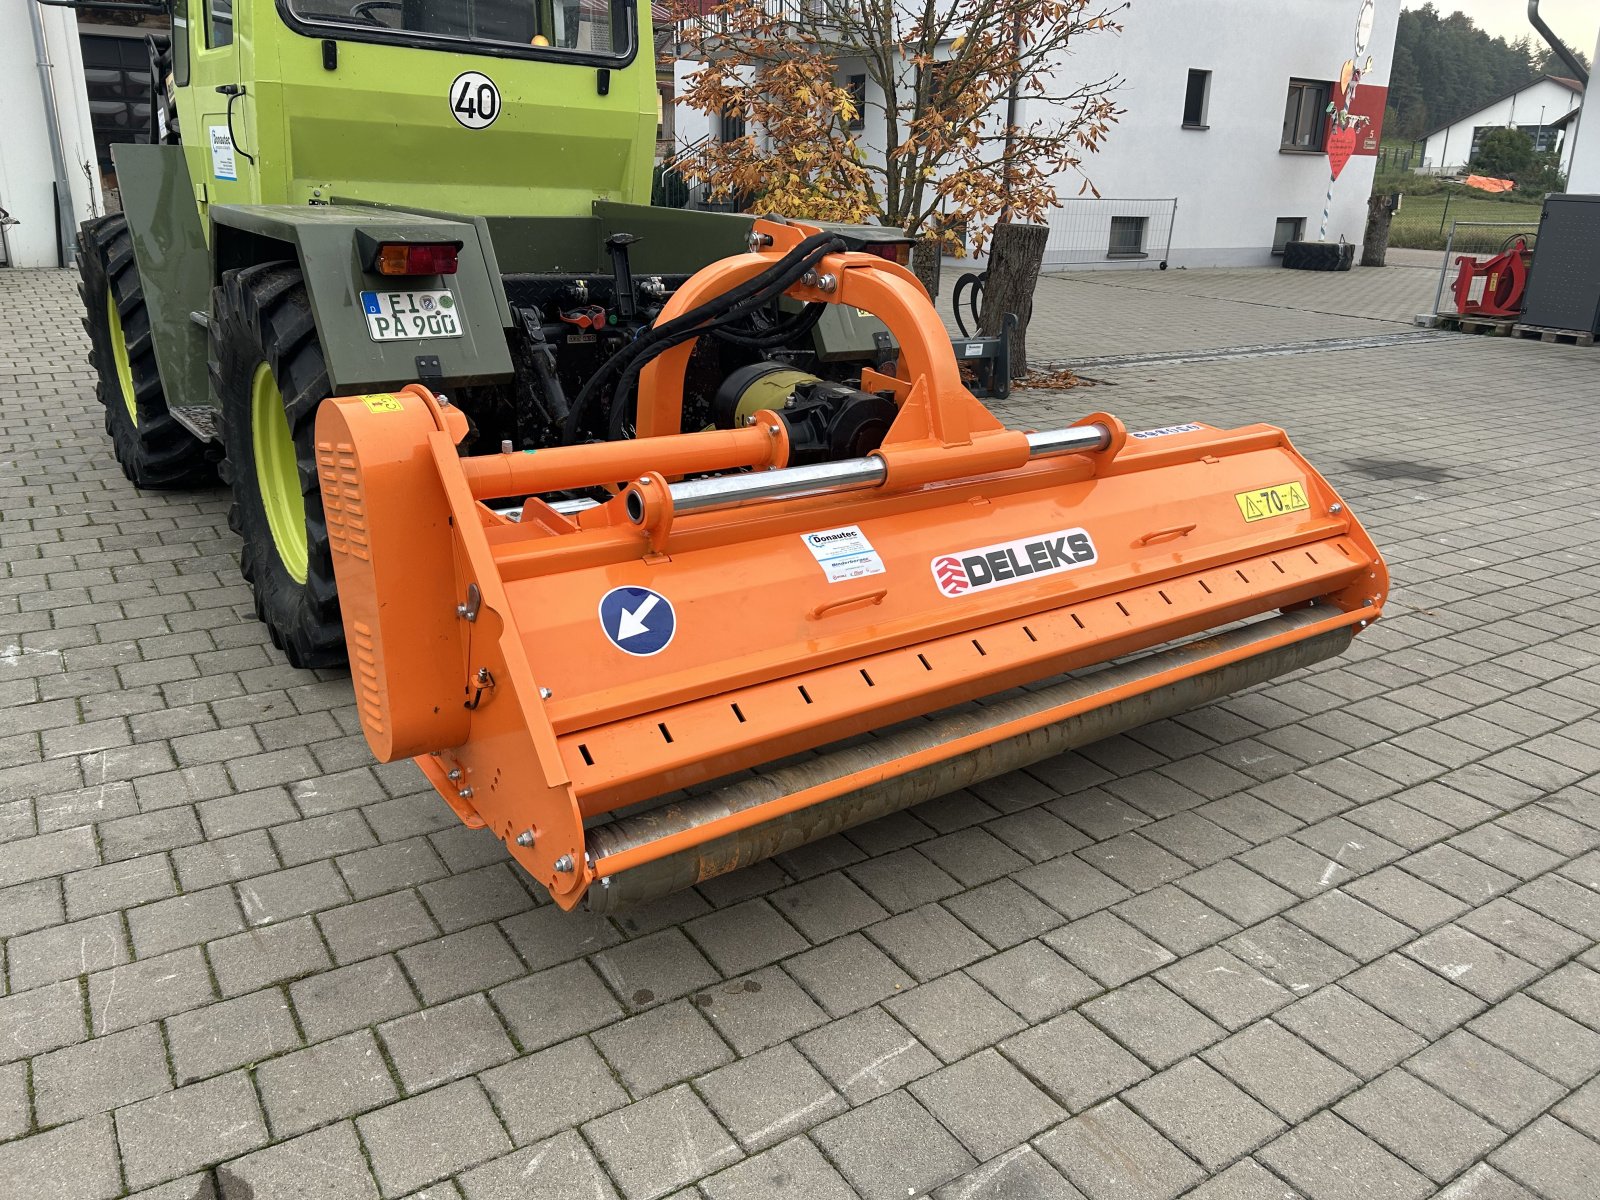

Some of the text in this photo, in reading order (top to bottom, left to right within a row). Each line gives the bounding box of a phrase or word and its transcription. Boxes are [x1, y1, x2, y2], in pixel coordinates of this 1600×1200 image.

[455, 82, 496, 120] 40
[1369, 130, 1374, 138] 5
[370, 305, 377, 313] D
[387, 293, 420, 314] EI
[375, 314, 457, 337] PA 900
[1260, 489, 1284, 514] 70
[813, 531, 857, 543] Donautec
[962, 533, 1095, 587] DELEKS
